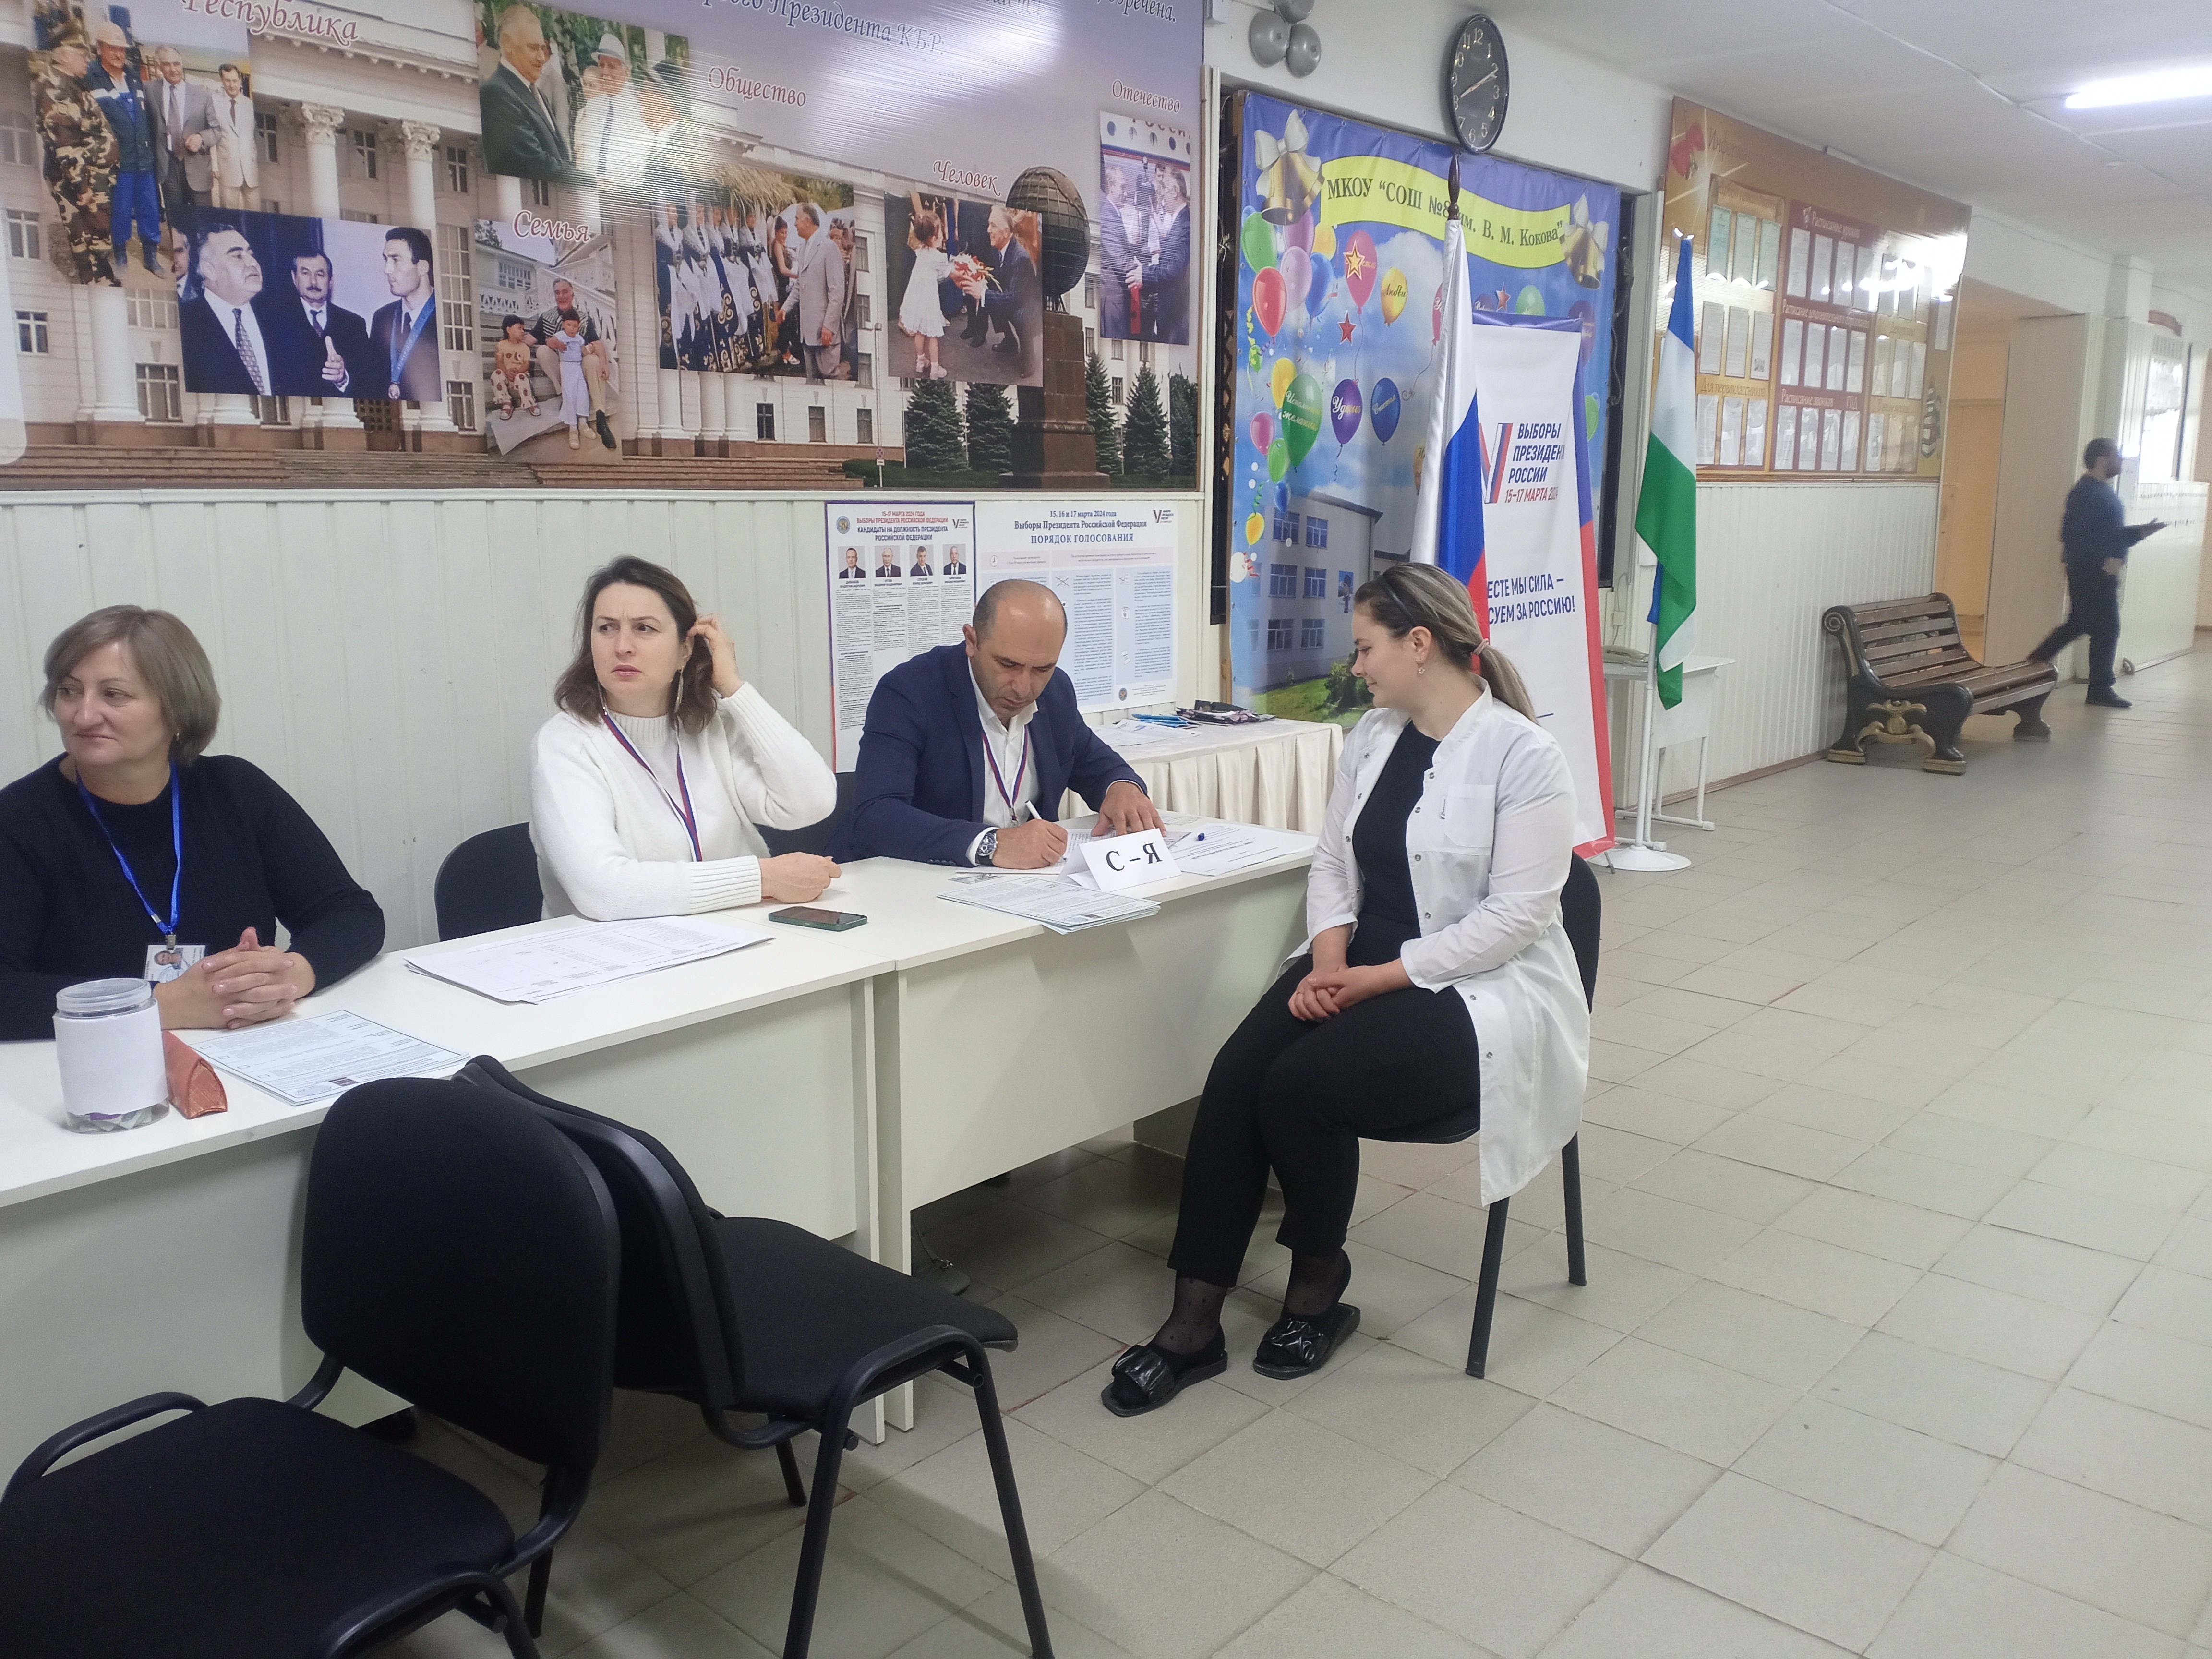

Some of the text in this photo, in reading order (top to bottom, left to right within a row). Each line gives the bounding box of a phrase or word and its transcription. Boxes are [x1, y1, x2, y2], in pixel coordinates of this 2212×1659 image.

[709, 67, 806, 107] Общество
[1113, 80, 1180, 113] Отечество
[933, 160, 1001, 197] Человек
[1326, 177, 1373, 200] МКОУ
[1482, 219, 1494, 240] В.
[1500, 226, 1514, 245] М.
[514, 211, 590, 241] Семья
[1517, 423, 1562, 439] ВЫБОРЫ
[1508, 467, 1548, 483] РОССИИ
[1524, 487, 1548, 502] МАРТА
[1014, 519, 1147, 531] Выборы Президента Российской Федерации
[1031, 533, 1133, 545] ПОРЯДОК ГОЛОСОВАНИЯ
[1488, 579, 1510, 599] ЕСТЕ
[1511, 577, 1527, 595] МЫ
[1529, 574, 1554, 593] СИЛА
[1489, 595, 1575, 625] СУЕМ ЗА РОССИЮ!
